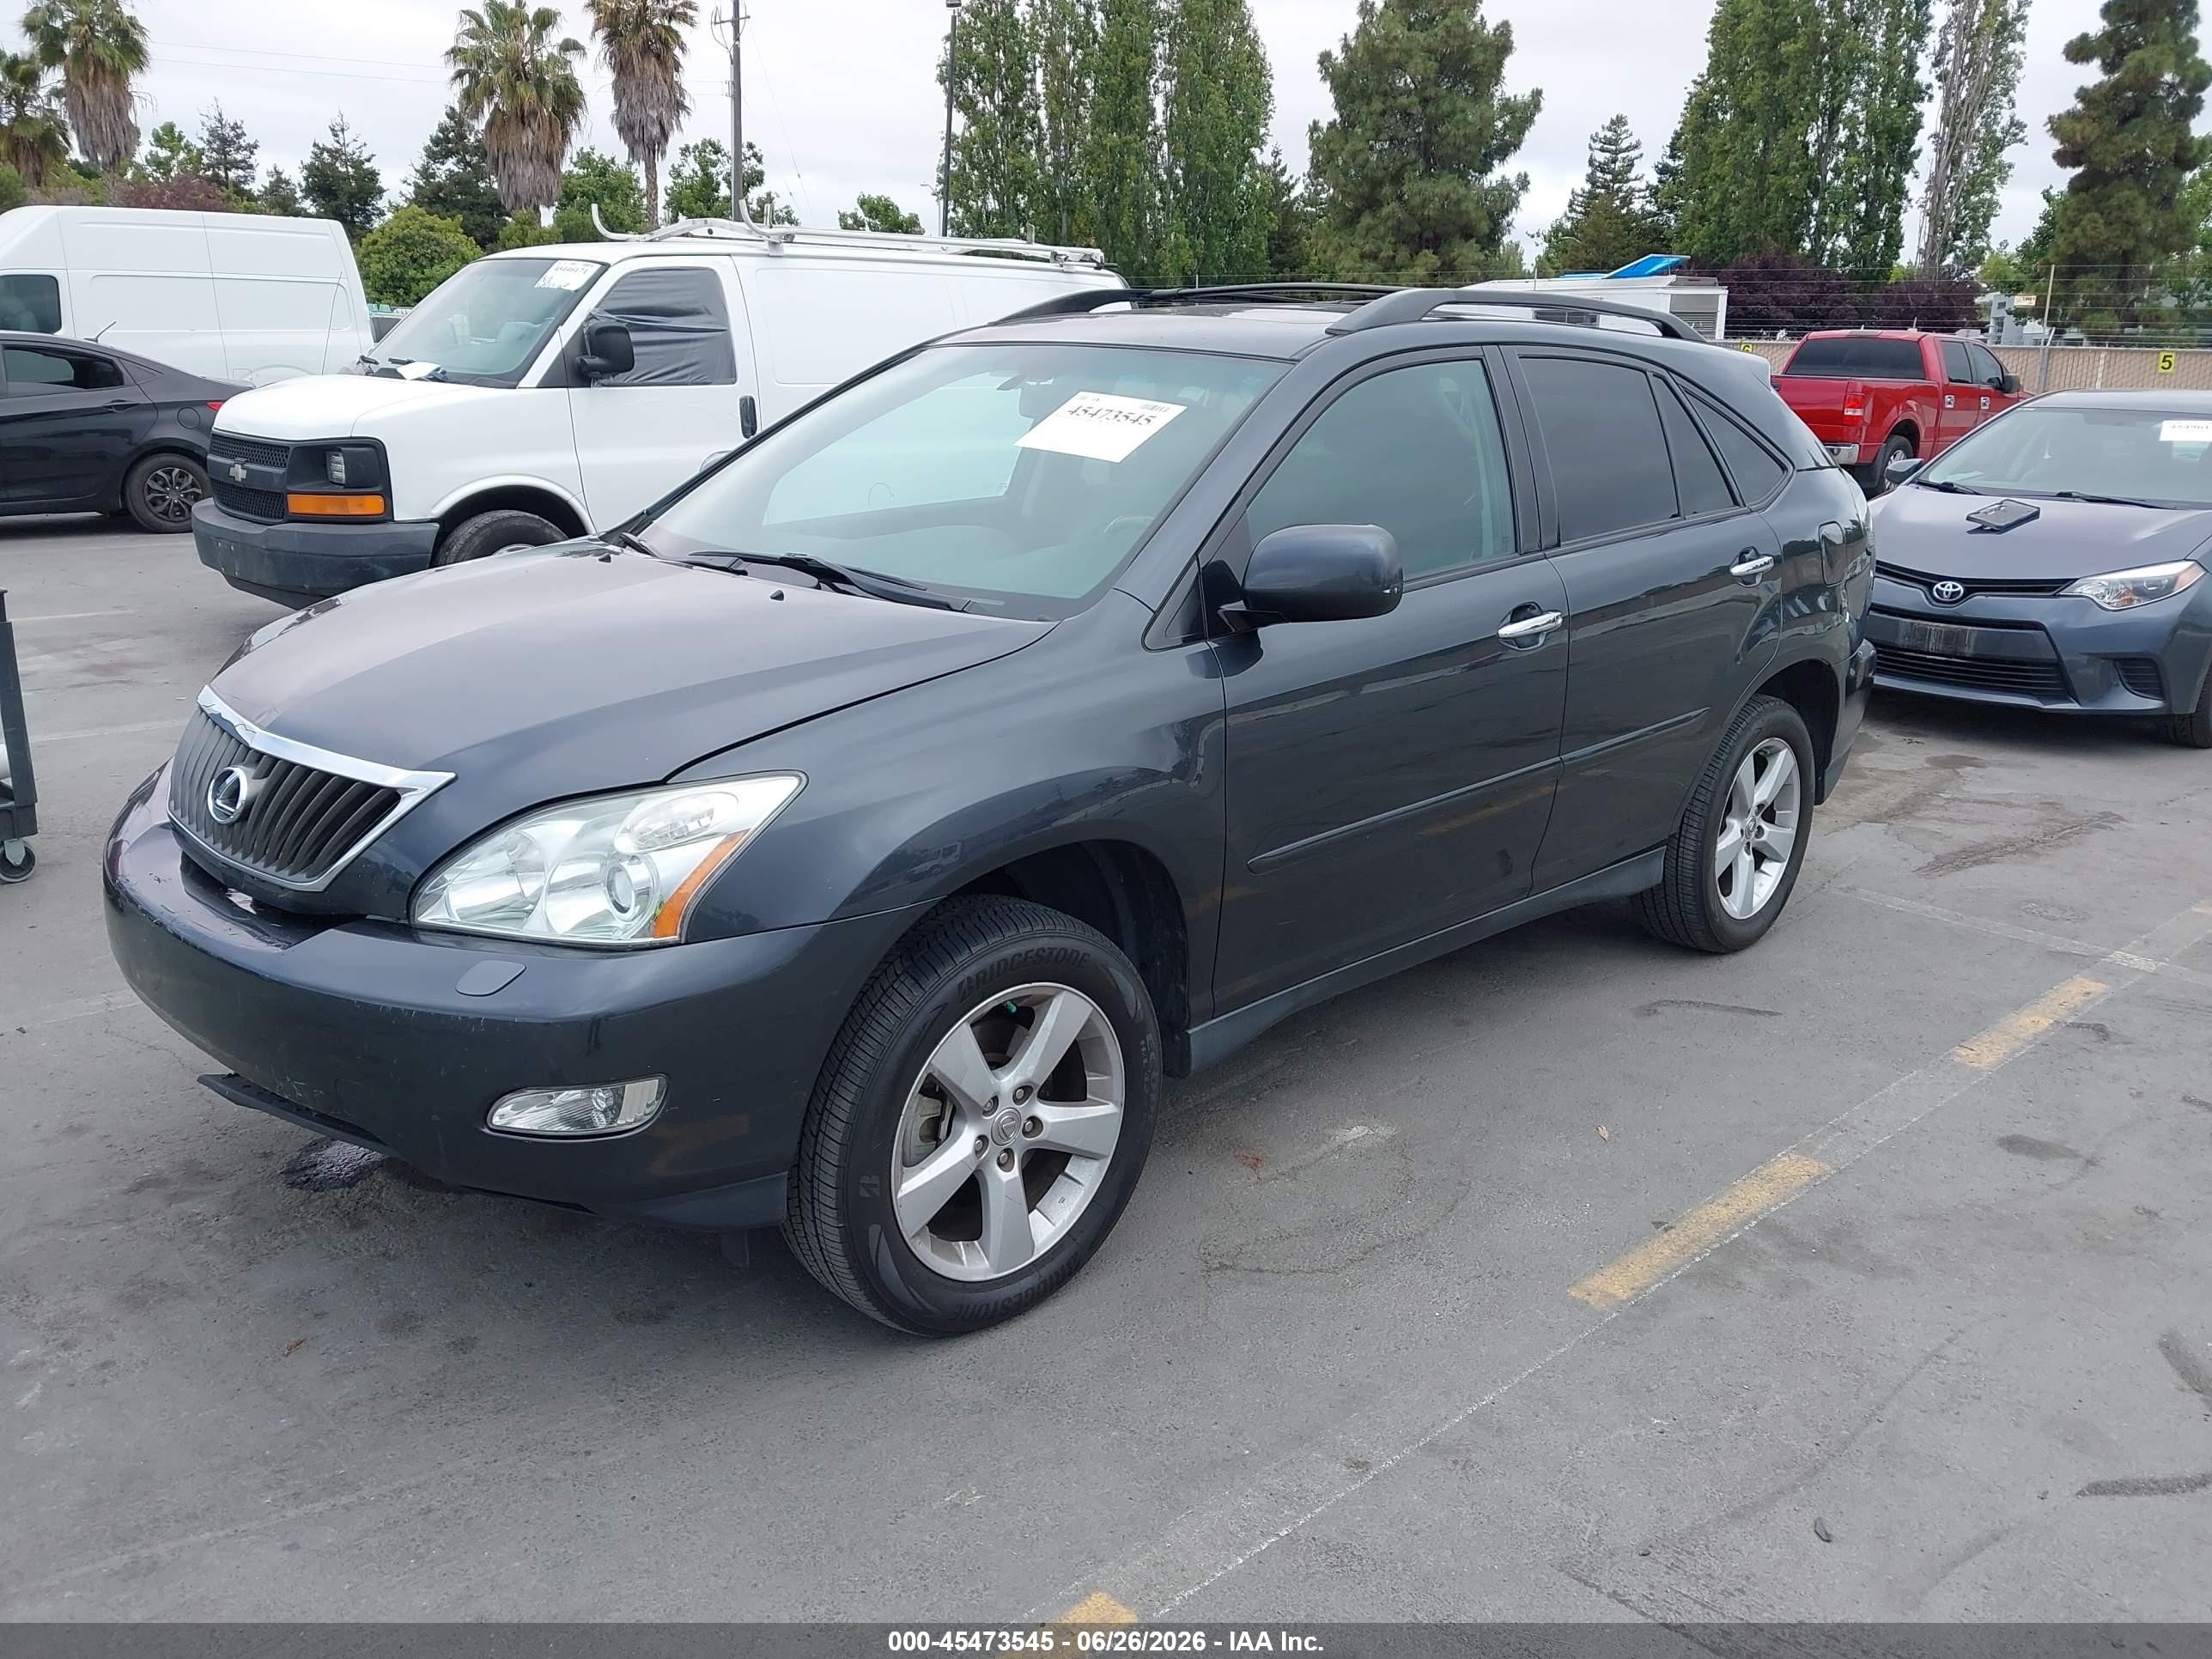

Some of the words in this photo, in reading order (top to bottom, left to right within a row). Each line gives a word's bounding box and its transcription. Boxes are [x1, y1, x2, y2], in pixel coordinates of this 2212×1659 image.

[2160, 355, 2173, 370] 5
[1066, 404, 1158, 426] 45473545
[956, 946, 1091, 1004] BRIDGESTONE
